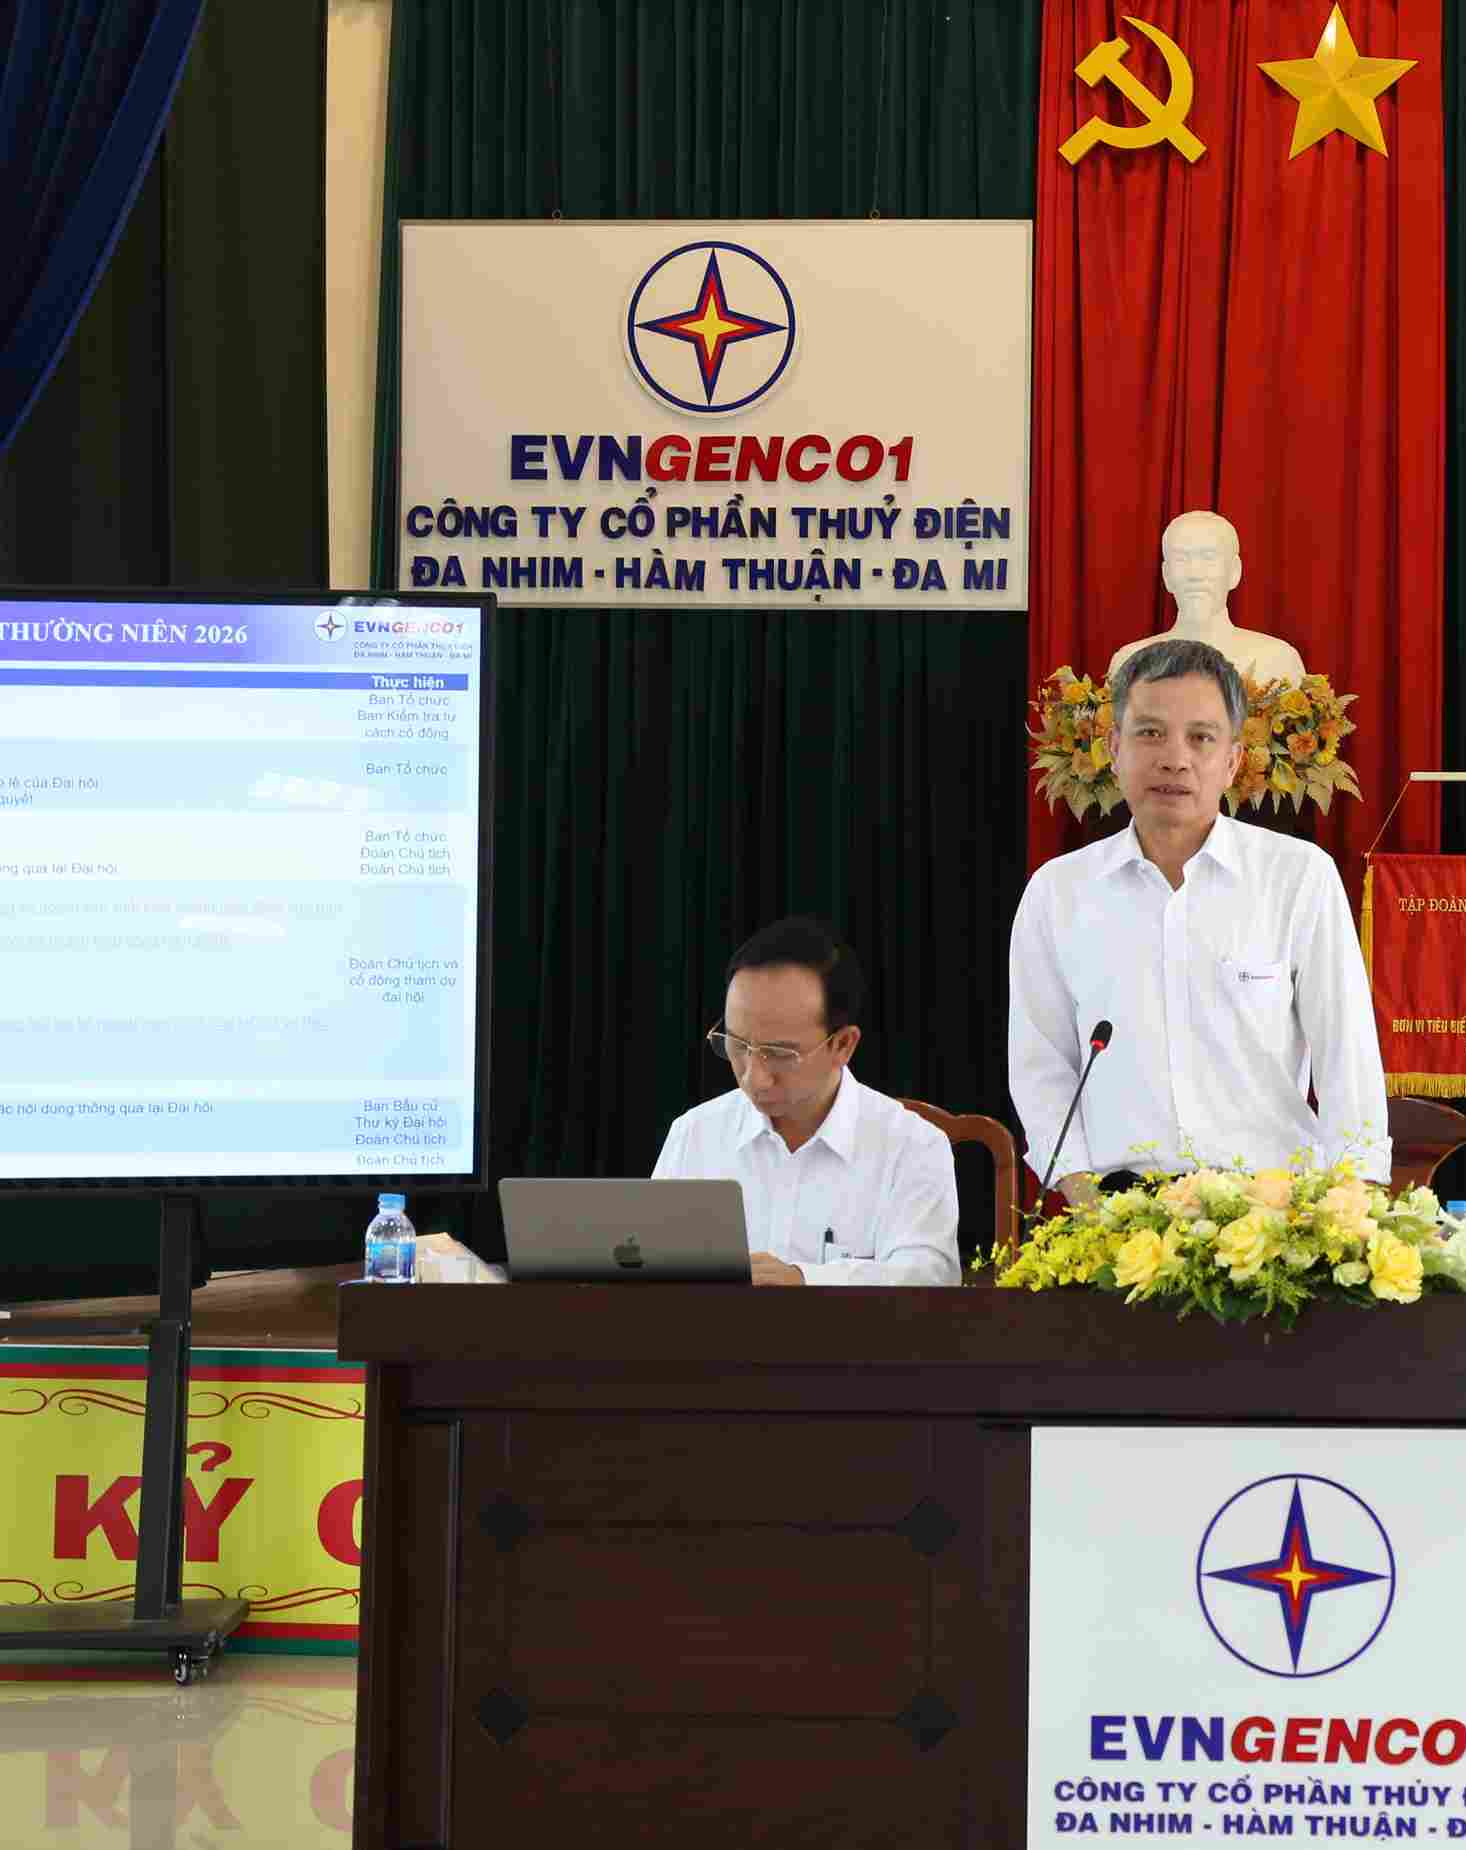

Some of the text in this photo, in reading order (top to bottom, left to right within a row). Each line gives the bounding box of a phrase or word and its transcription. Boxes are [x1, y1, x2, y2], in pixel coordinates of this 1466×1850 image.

[510, 434, 914, 482] EVNGENCO1
[406, 486, 1011, 550] CÔNG TY CỔ PHẦN THUỶ ĐIỆN
[410, 548, 1010, 603] ĐA NHIM HÀM THUẬN ĐA MI
[0, 617, 249, 644] THƯỜNG NIÊN 2026
[372, 675, 445, 691] Thực hiện
[369, 691, 415, 705] Ban Tổ
[358, 709, 384, 720] Ban
[366, 762, 392, 774] Ban
[366, 830, 390, 841] Ban
[1398, 895, 1425, 915] TẬP
[1427, 1016, 1448, 1034] TIÊU
[119, 1104, 144, 1118] qua
[364, 1099, 388, 1111] Ban
[1054, 1779, 1145, 1804] CÔNG
[1157, 1782, 1197, 1804] TY
[1208, 1774, 1254, 1805] CỔ
[1264, 1775, 1352, 1806] PHẦN
[1363, 1777, 1451, 1808] THỦY
[1055, 1811, 1099, 1834] ĐA
[1110, 1812, 1193, 1835] NHIM
[1223, 1807, 1294, 1836] HÀM
[1305, 1810, 1417, 1841] THUẬN
